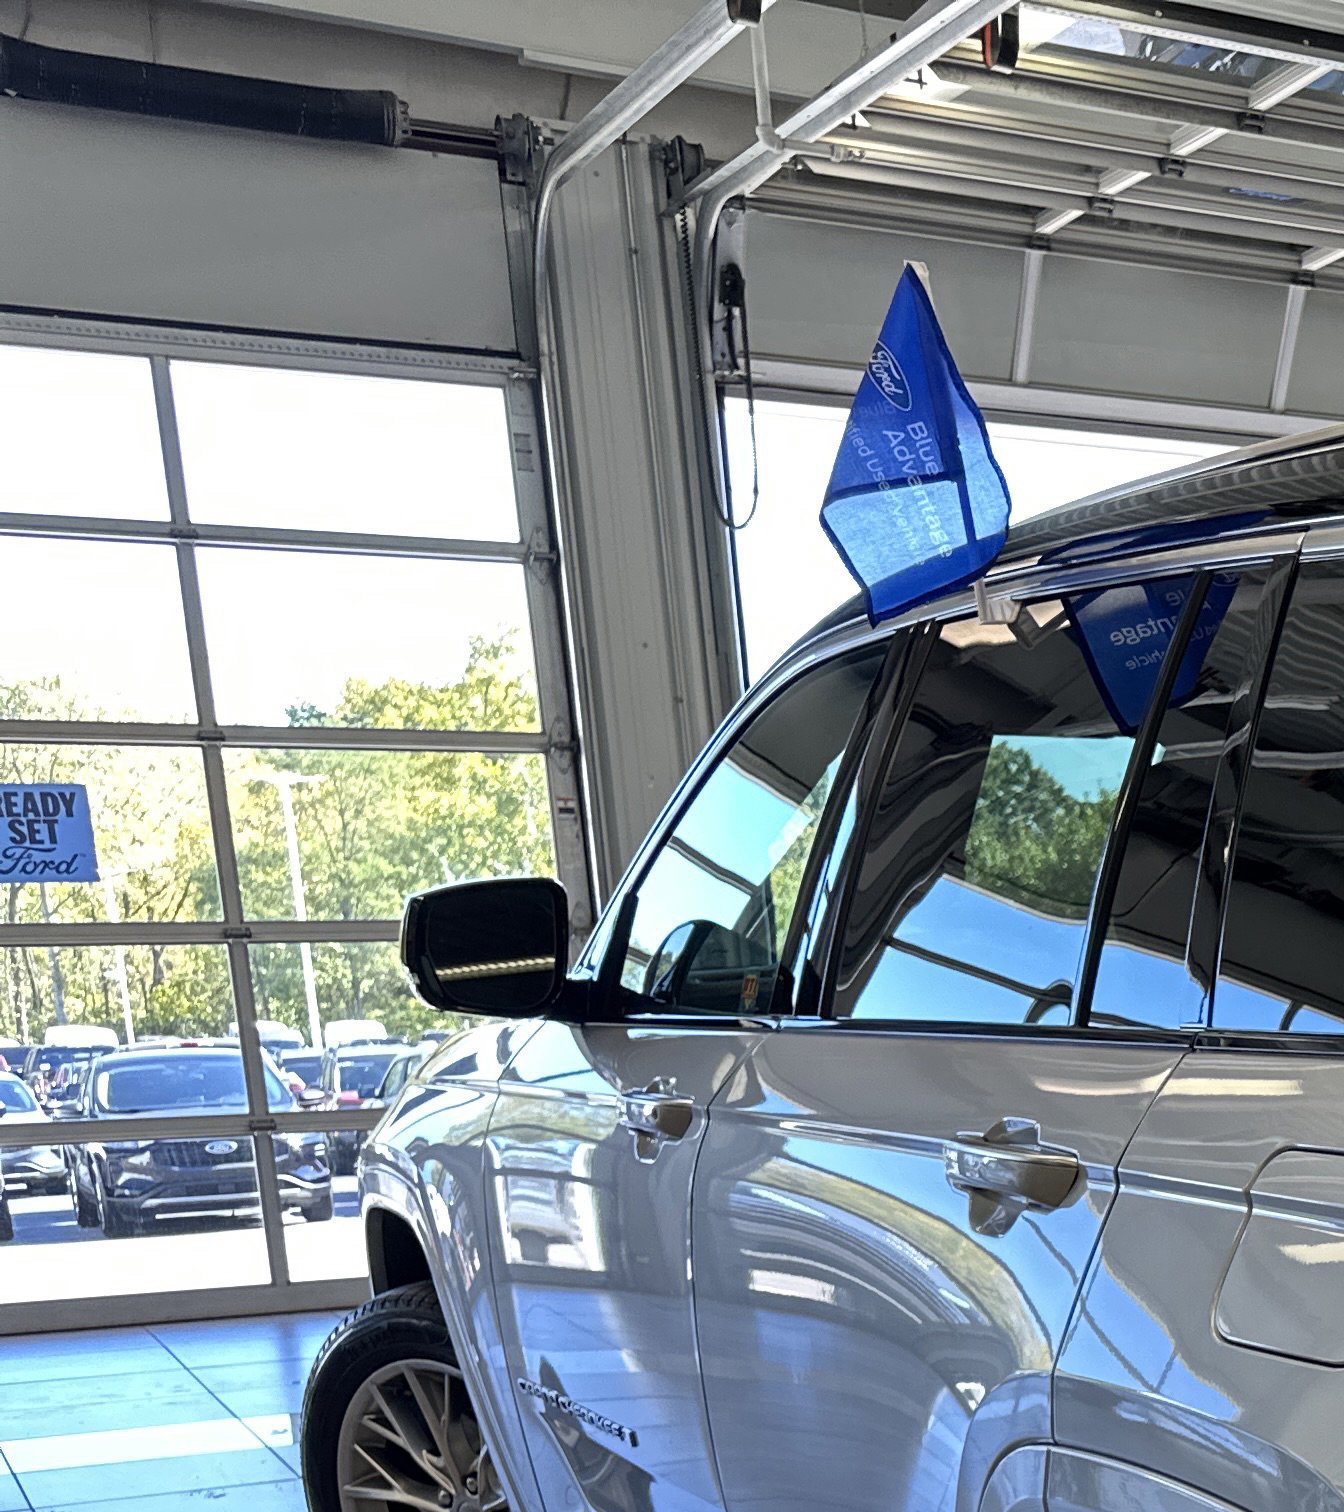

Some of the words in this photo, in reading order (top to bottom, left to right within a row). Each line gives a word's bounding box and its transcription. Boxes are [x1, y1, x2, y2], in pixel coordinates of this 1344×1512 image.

[869, 350, 904, 396] Ford
[906, 420, 940, 477] Blue
[881, 428, 954, 558] Advantage
[0, 791, 77, 818] EADY
[7, 818, 59, 845] SET
[0, 845, 79, 875] Ford
